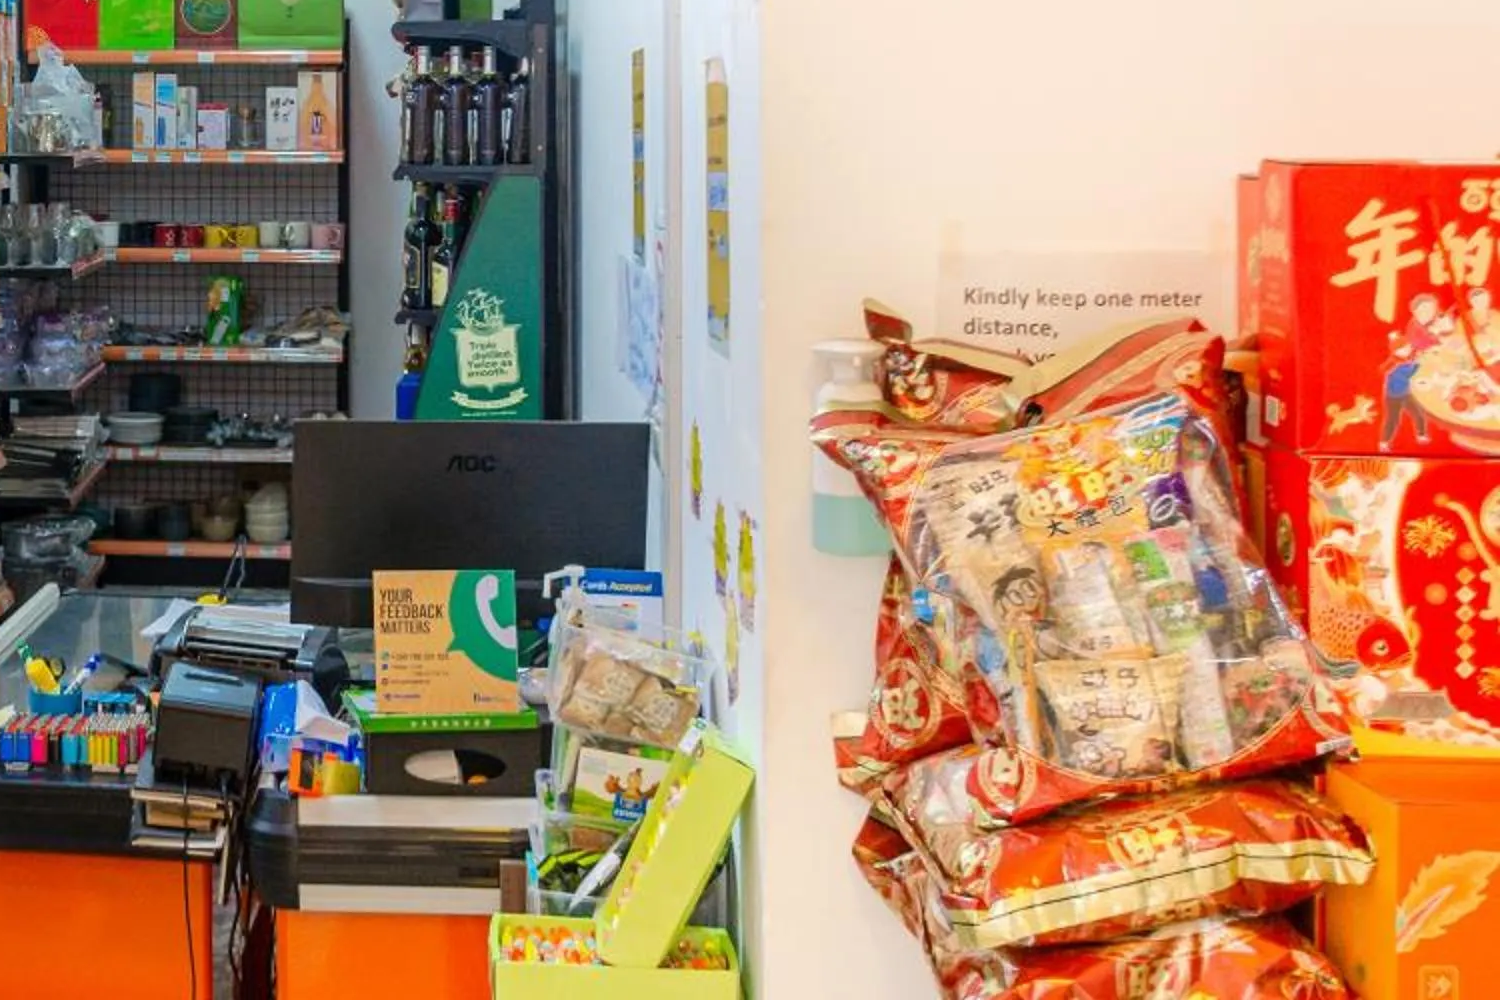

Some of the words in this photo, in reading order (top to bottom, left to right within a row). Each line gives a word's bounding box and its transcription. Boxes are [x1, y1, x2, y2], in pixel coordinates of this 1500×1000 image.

[1328, 197, 1500, 324] 年的
[963, 287, 1030, 310] Kindly
[1036, 288, 1087, 310] keep
[1094, 292, 1134, 307] one
[1140, 291, 1202, 307] meter
[963, 317, 1059, 339] distance,
[379, 588, 413, 603] YOUR
[380, 603, 444, 620] FEEDBACK
[380, 620, 431, 635] MATTERS
